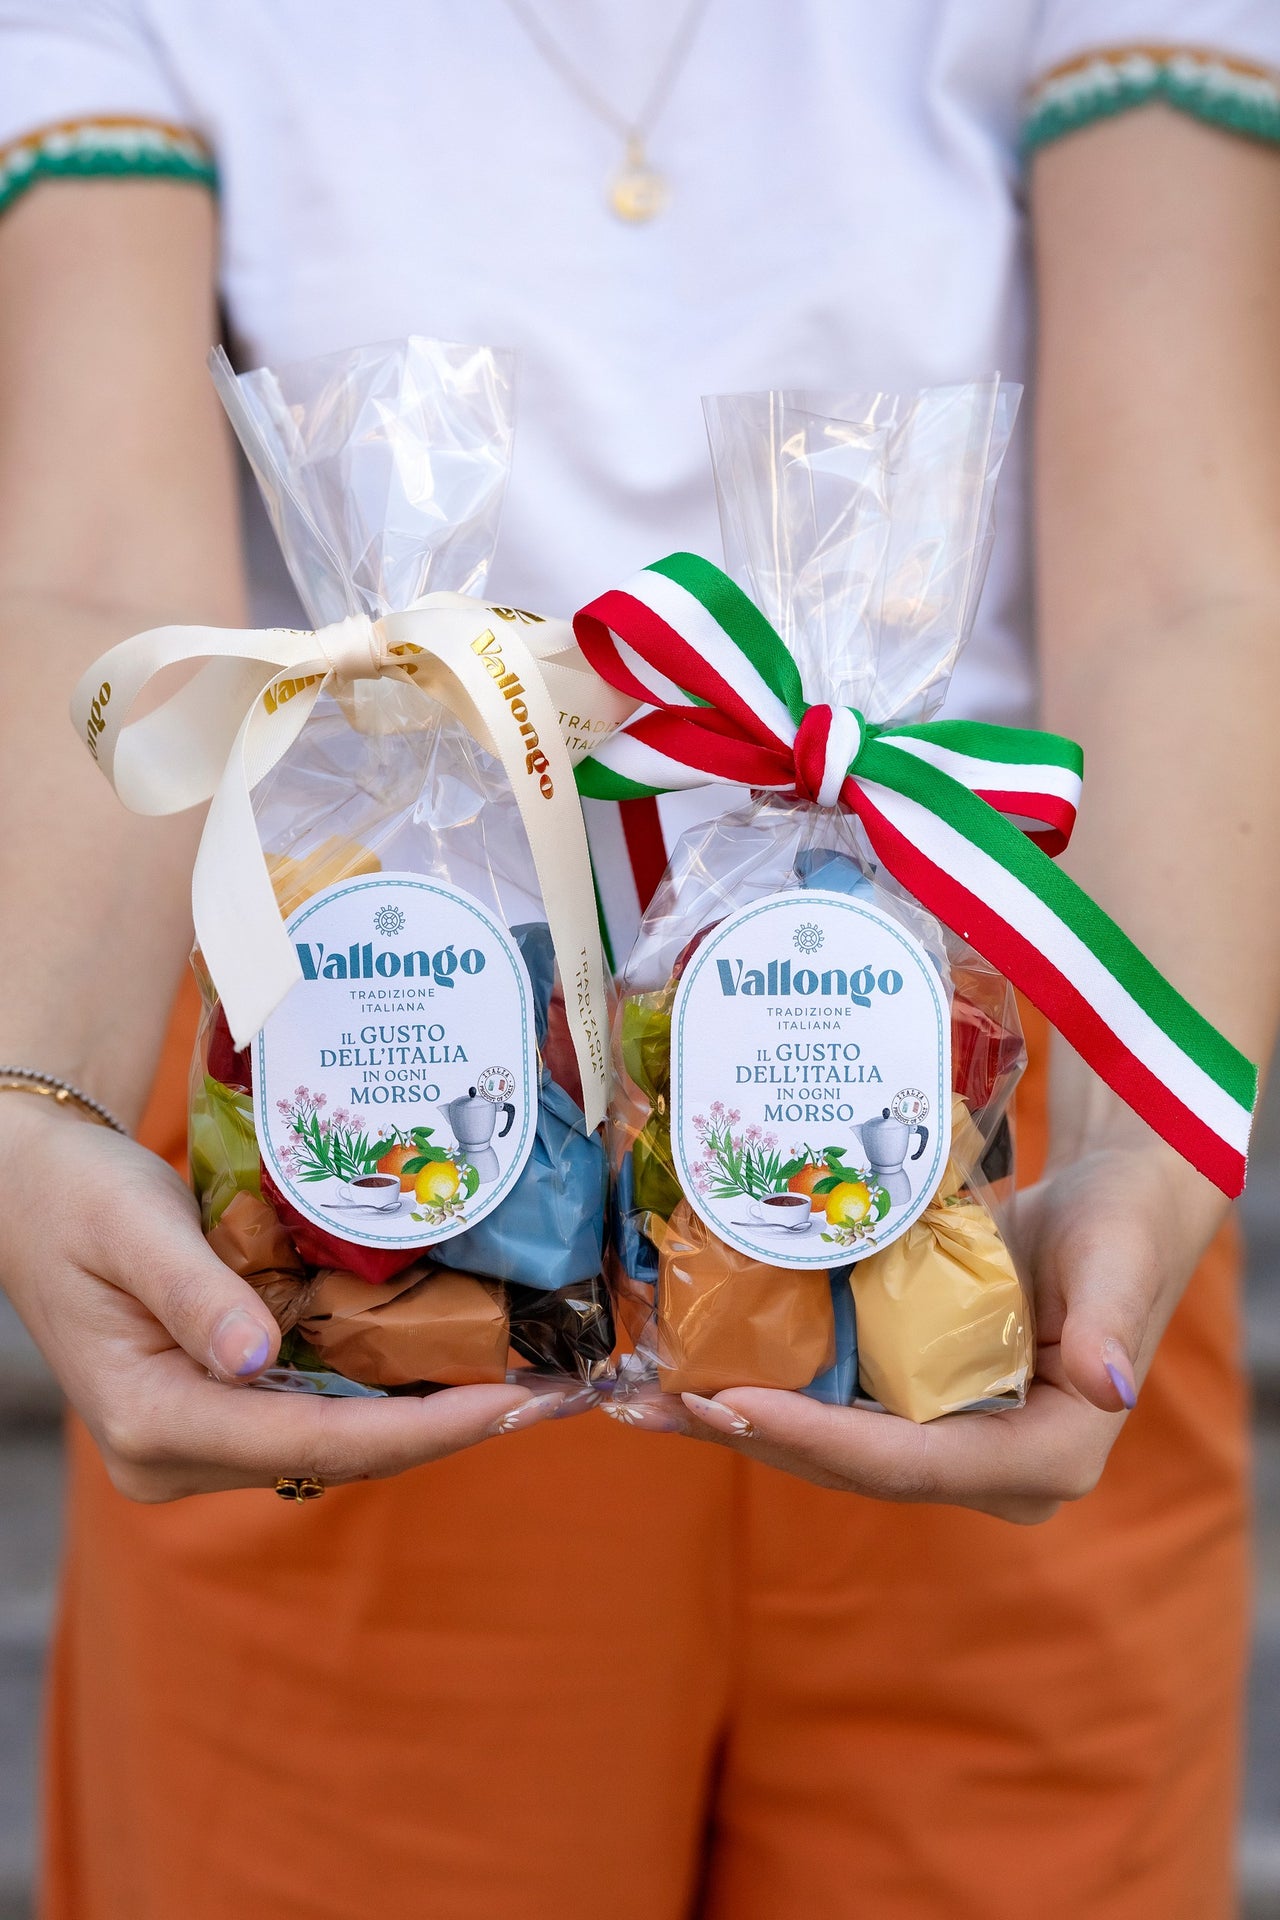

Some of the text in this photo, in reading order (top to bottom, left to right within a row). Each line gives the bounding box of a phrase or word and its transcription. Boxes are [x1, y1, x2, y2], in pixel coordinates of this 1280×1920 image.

[470, 628, 554, 800] Vallongo
[295, 942, 486, 989] Vallongo
[716, 958, 904, 1009] Vallongo
[349, 988, 435, 1000] TRADIZIONE
[361, 1002, 425, 1013] ITALIANA
[580, 947, 606, 1085] TRADIZIONE
[767, 1007, 852, 1017] TRADIZIONE
[575, 971, 598, 1074] ITALIANA
[778, 1021, 841, 1031] ITALIANA
[341, 1024, 446, 1045] IL GUSTO
[320, 1045, 469, 1068] DELL’ITALIA
[757, 1043, 861, 1062] IL GUSTO
[363, 1069, 427, 1082] IN OGNI
[483, 1067, 510, 1079] ITALIA
[735, 1065, 883, 1084] DELL’ITALIA
[350, 1084, 441, 1105] MORSO
[777, 1088, 841, 1100] IN OGNI
[896, 1089, 924, 1100] ITALIA
[763, 1103, 854, 1122] MORSO
